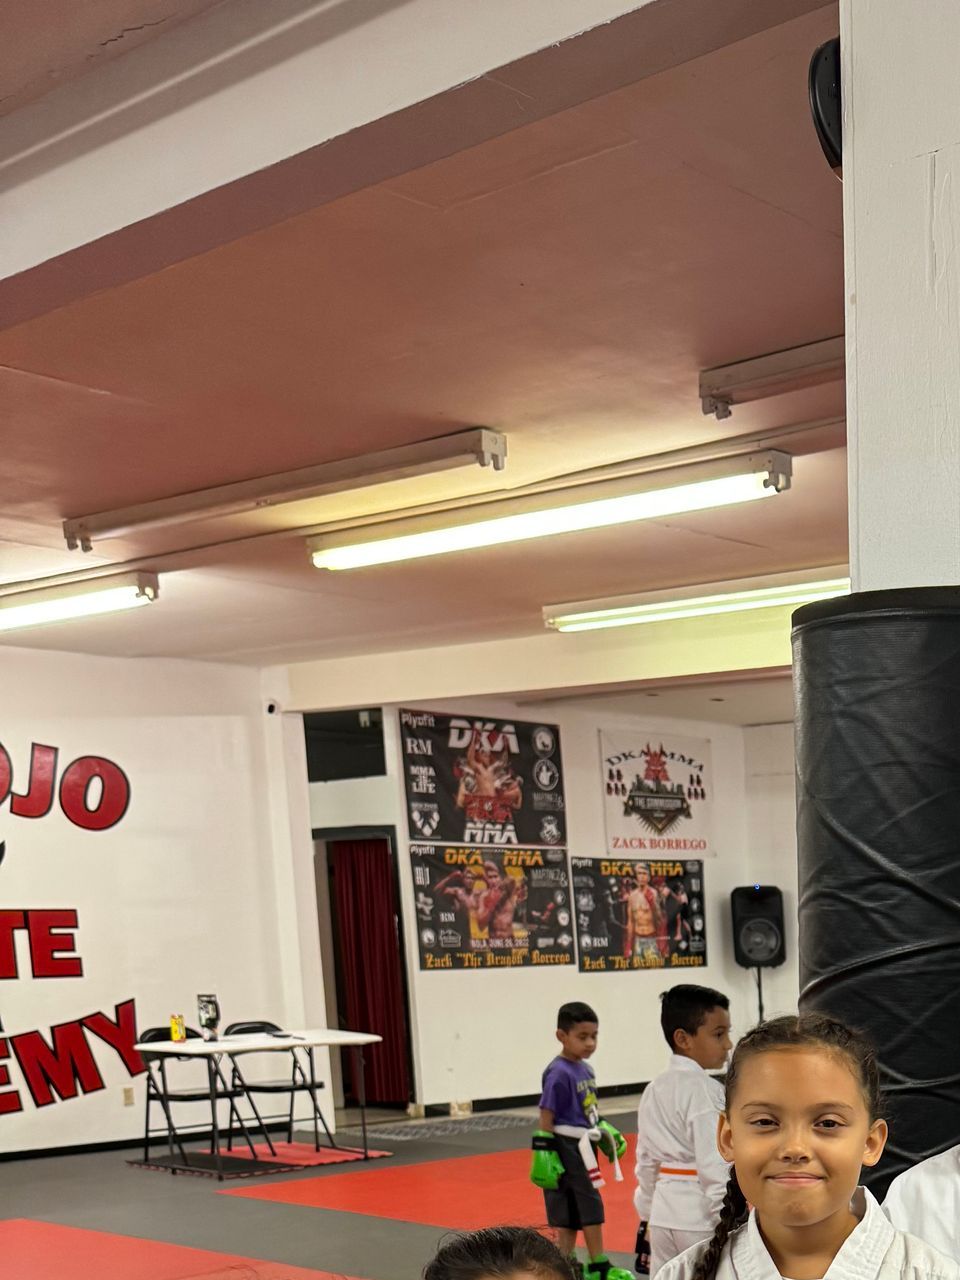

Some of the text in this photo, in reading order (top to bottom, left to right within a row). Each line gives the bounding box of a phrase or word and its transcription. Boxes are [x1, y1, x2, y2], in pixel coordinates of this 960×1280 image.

[448, 718, 520, 754] DKA
[406, 738, 433, 755] RM
[606, 750, 704, 772] DKA MMA
[0, 742, 130, 831] JO
[464, 821, 518, 844] MMA
[612, 837, 707, 850] ZACK BORREGO
[444, 848, 483, 864] DKA
[503, 850, 544, 866] MMA
[601, 861, 633, 875] DKA
[650, 862, 683, 876] MMA
